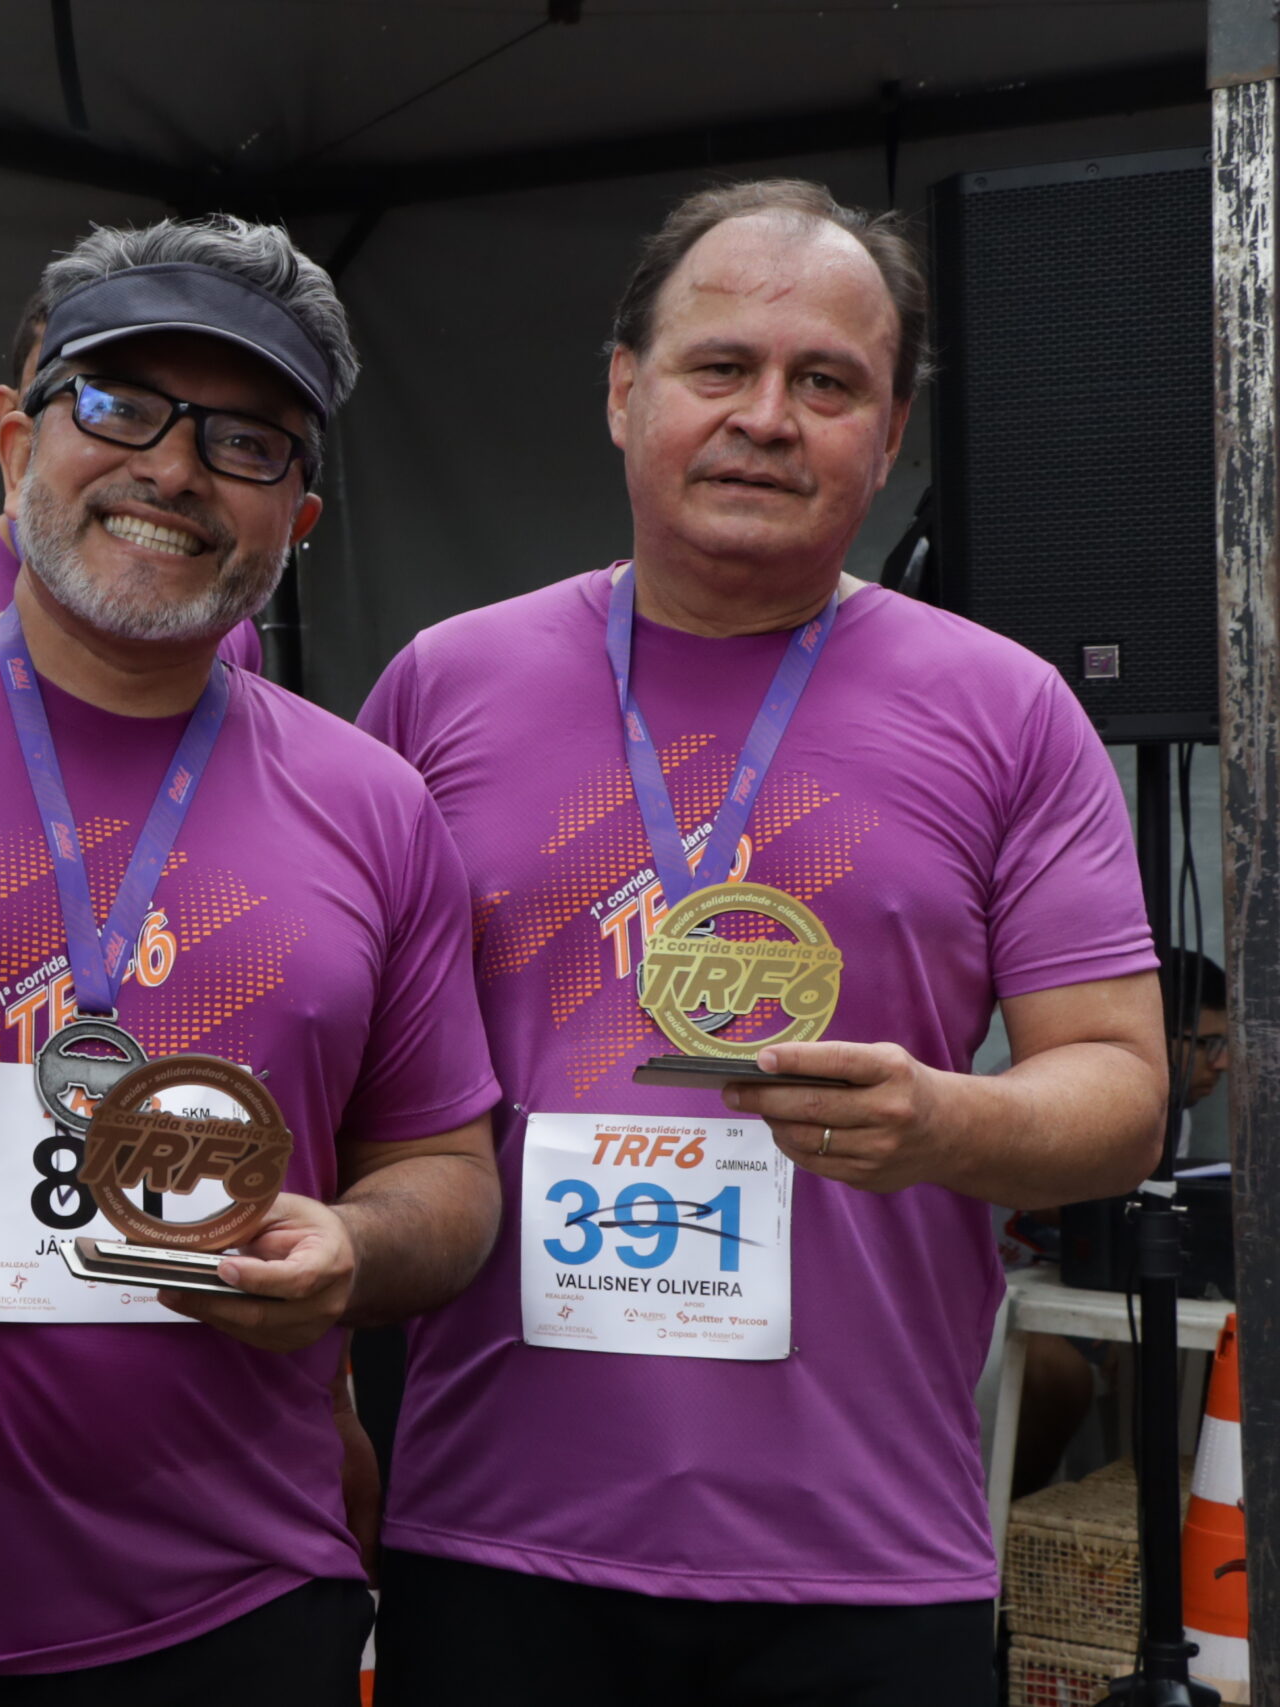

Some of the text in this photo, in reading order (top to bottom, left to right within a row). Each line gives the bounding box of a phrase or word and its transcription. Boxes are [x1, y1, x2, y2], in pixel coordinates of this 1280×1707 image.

[607, 868, 655, 908] corrida
[700, 892, 772, 912] solidariedade
[777, 904, 818, 944] cidadania
[667, 939, 731, 954] corrida
[735, 943, 812, 960] solidária
[816, 948, 838, 960] do
[15, 954, 69, 995] corrida
[641, 953, 839, 1019] TRF6
[664, 1010, 688, 1039] saúde
[154, 1066, 229, 1083] solidariedade
[234, 1079, 271, 1125] cidadania
[114, 1111, 180, 1132] corrida
[184, 1116, 264, 1140] solidária
[269, 1128, 290, 1143] do
[604, 1124, 643, 1133] corrida
[644, 1125, 692, 1136] solidária
[693, 1127, 707, 1136] do
[726, 1128, 744, 1137] 391
[80, 1124, 291, 1201] TRF6
[591, 1133, 707, 1169] TRF6
[715, 1159, 768, 1172] CAMINHADA
[103, 1185, 257, 1245] saúde solidariedade cidadania
[543, 1178, 741, 1272] 391
[20, 1297, 52, 1305] FEDERAL
[556, 1272, 743, 1298] VALLISNEY OLIVEIRA
